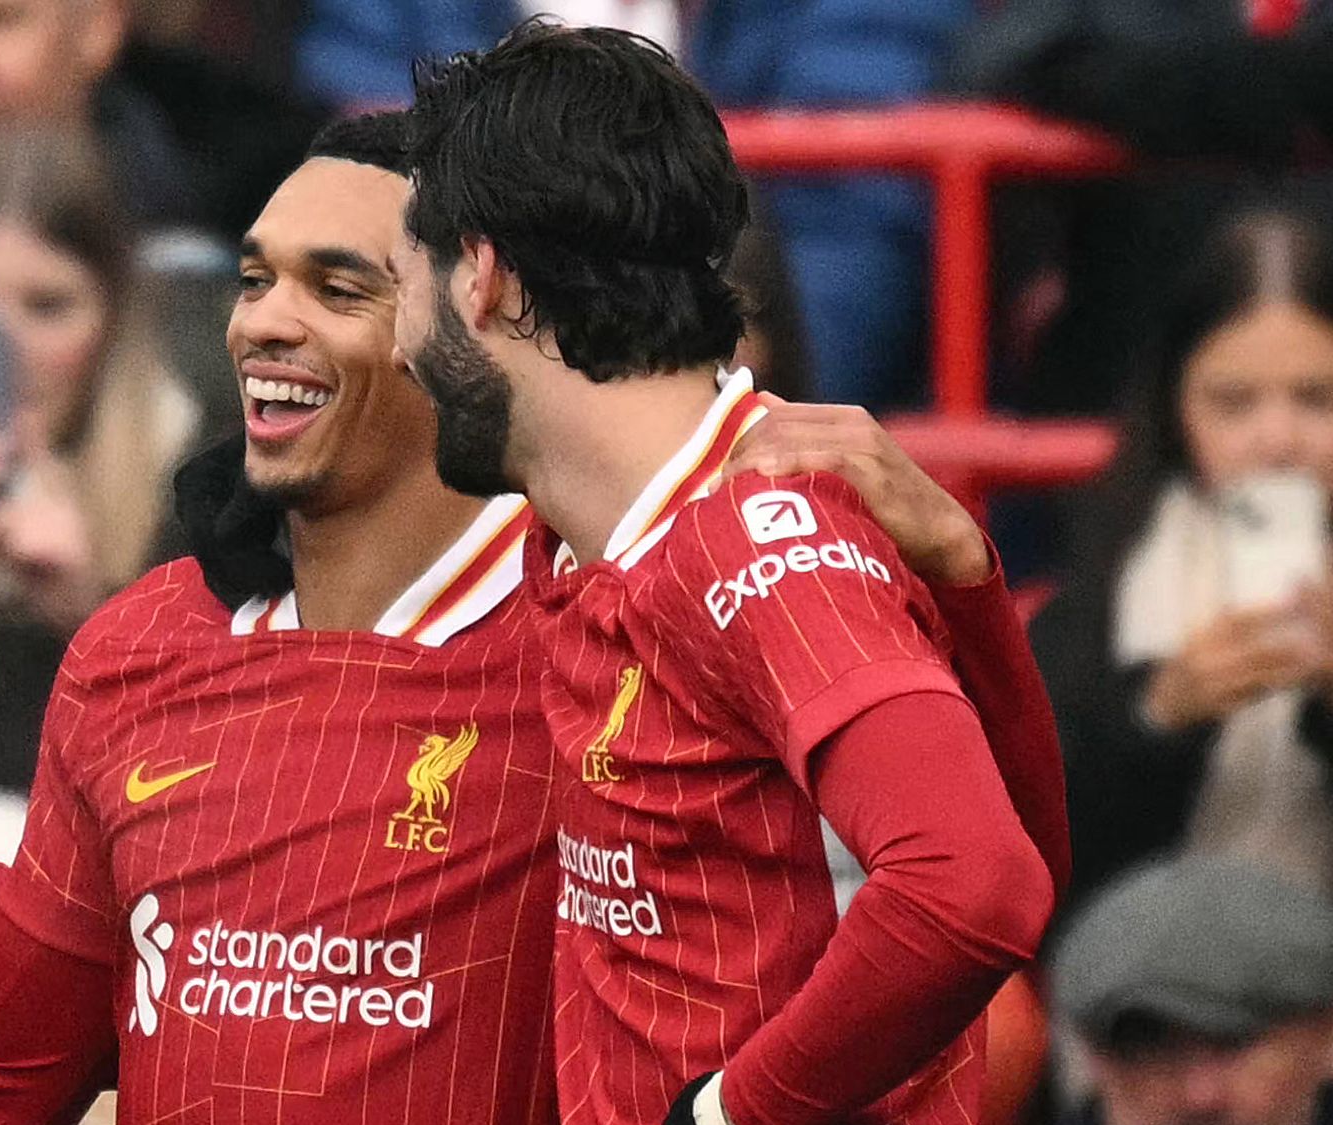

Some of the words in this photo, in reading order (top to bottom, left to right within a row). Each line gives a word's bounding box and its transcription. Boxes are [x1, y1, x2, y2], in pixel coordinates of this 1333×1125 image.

[704, 538, 892, 631] Expedia
[557, 823, 636, 889] stadard
[187, 919, 422, 978] standard
[180, 969, 434, 1029] chartered
